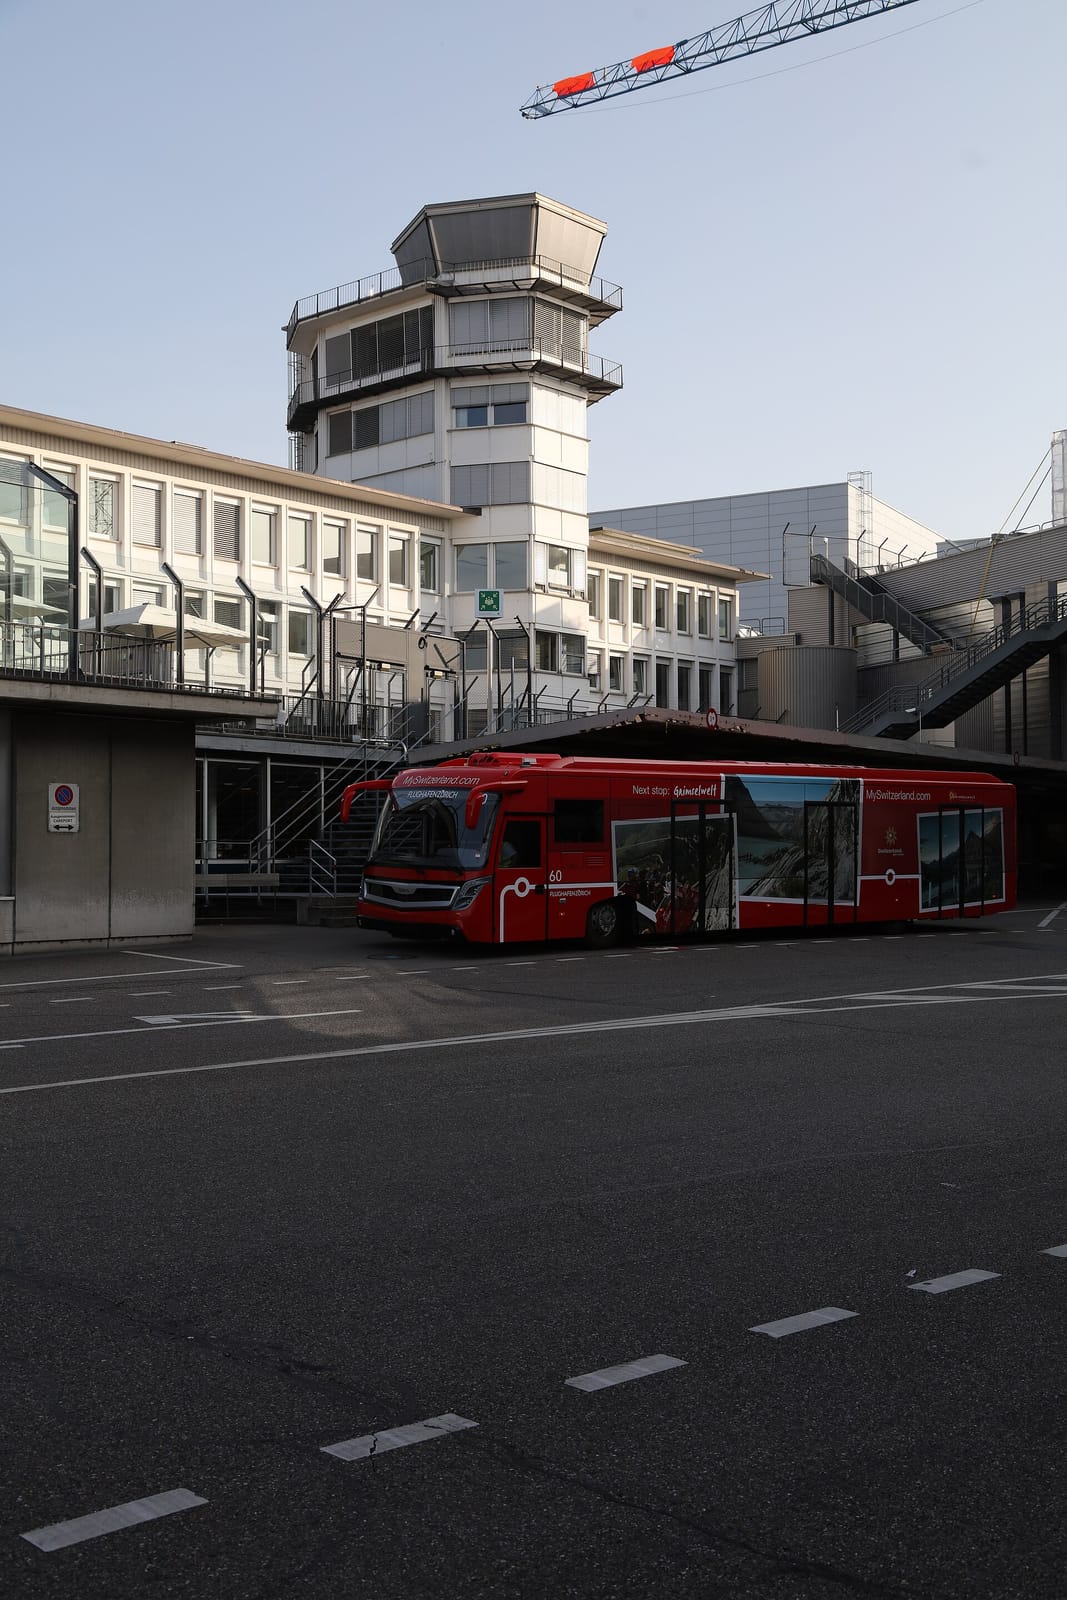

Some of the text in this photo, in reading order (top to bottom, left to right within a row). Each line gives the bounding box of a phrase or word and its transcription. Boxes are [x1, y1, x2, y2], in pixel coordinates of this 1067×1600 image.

[403, 775, 480, 786] MySwitzerland.com
[632, 784, 717, 798] Next stop: Grimselwelt
[866, 789, 931, 802] MySwitzerland.com
[549, 869, 562, 882] 60
